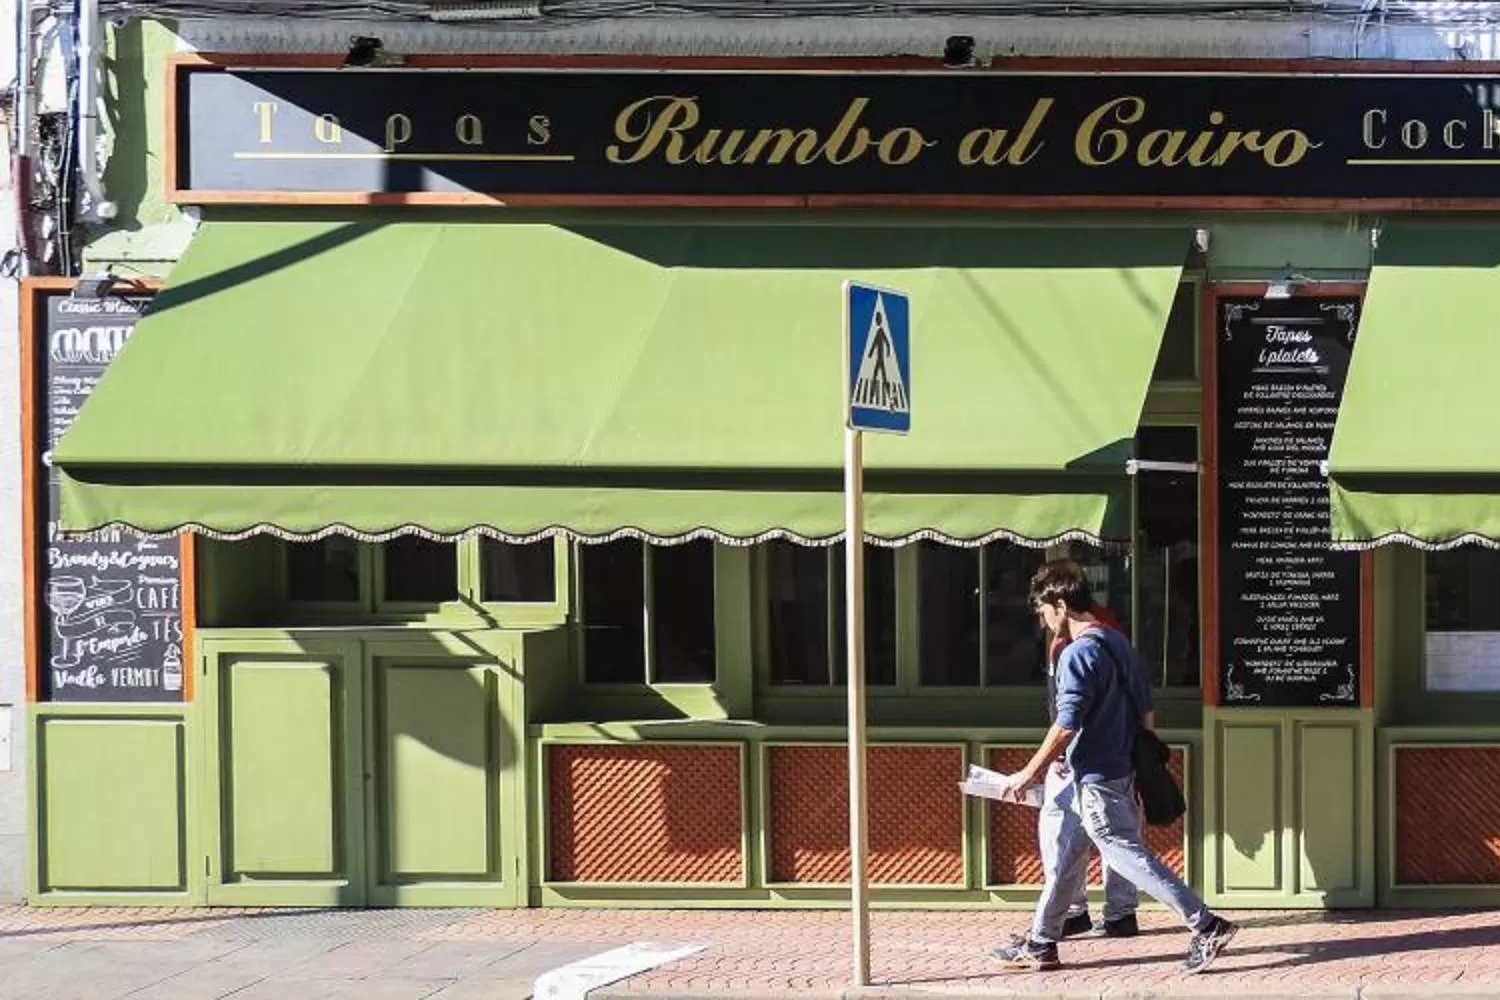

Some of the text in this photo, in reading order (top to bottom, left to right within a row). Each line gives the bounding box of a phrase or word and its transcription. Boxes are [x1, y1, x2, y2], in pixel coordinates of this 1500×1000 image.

[253, 101, 556, 154] Tapas
[605, 96, 1325, 168] Rumbo al Cairo
